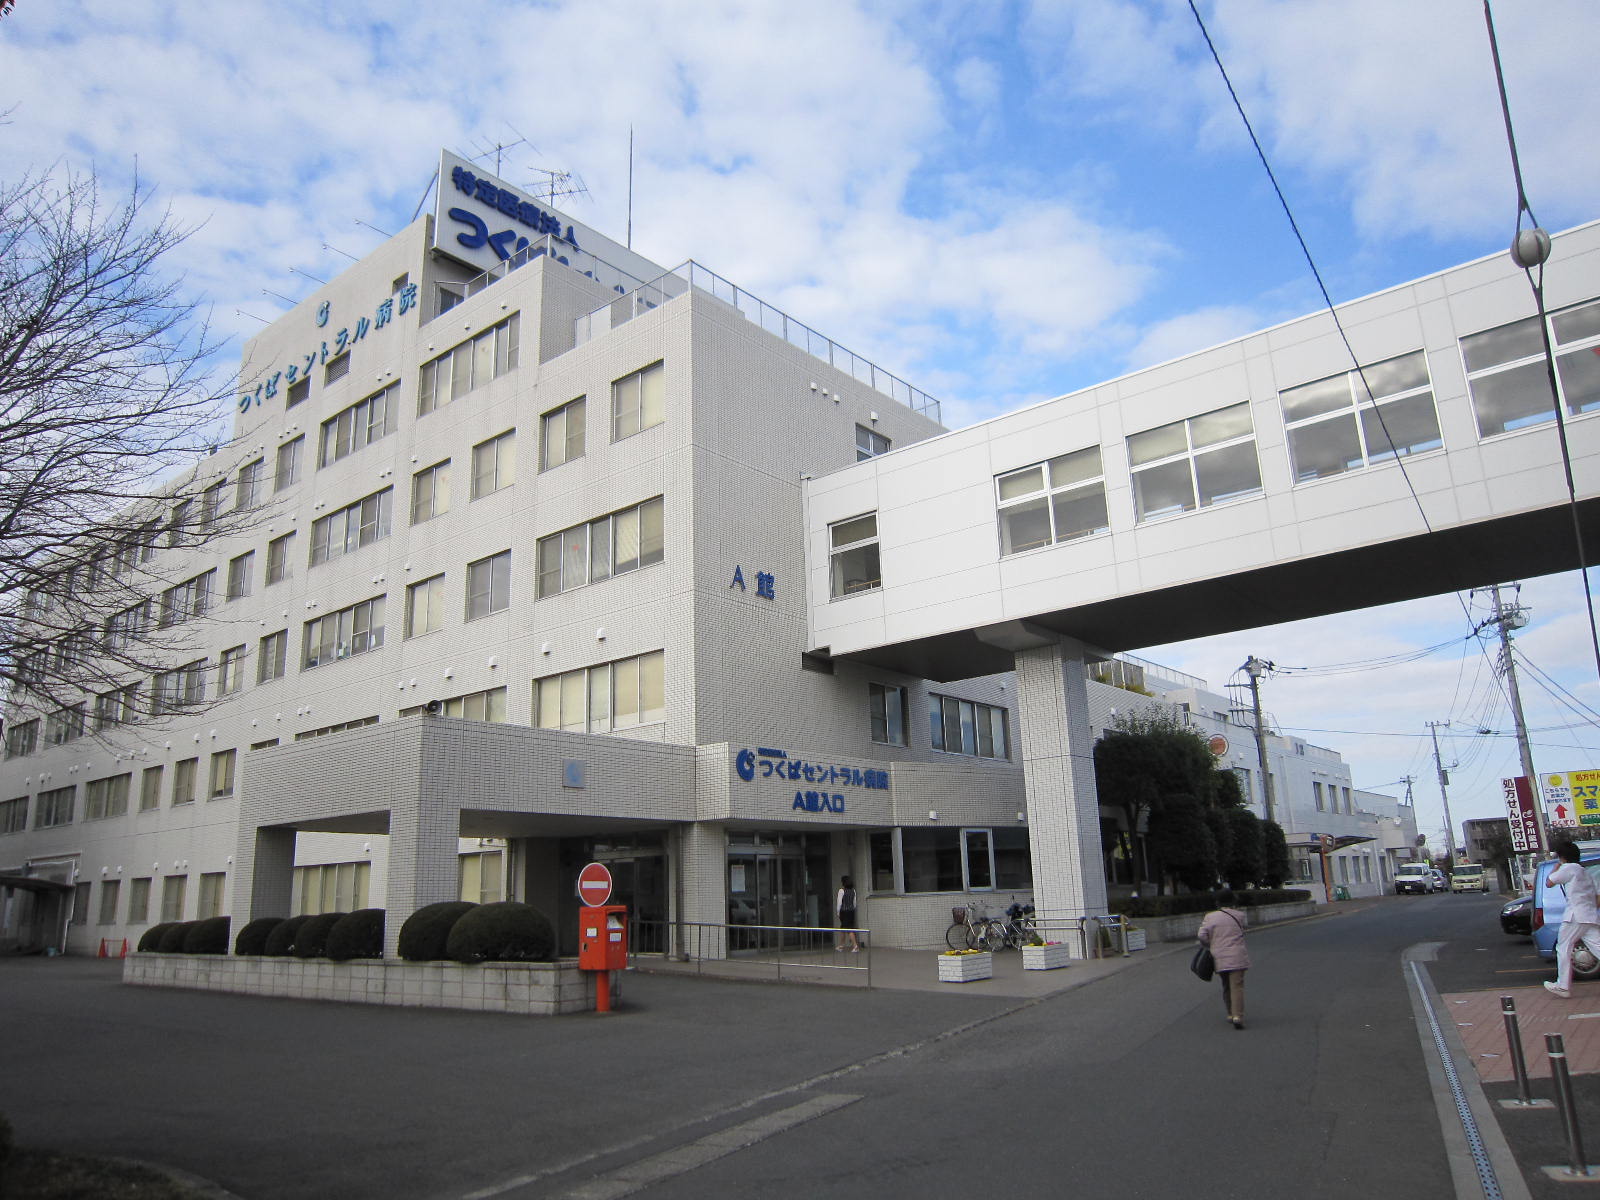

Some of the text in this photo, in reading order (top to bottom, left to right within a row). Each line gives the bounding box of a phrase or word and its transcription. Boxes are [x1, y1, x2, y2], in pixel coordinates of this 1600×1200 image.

[238, 282, 418, 414] つくばセントラル病院
[758, 759, 889, 790] つくばセントラル病院
[792, 790, 846, 813] A館入口
[1502, 778, 1527, 850] 処方せん受付中
